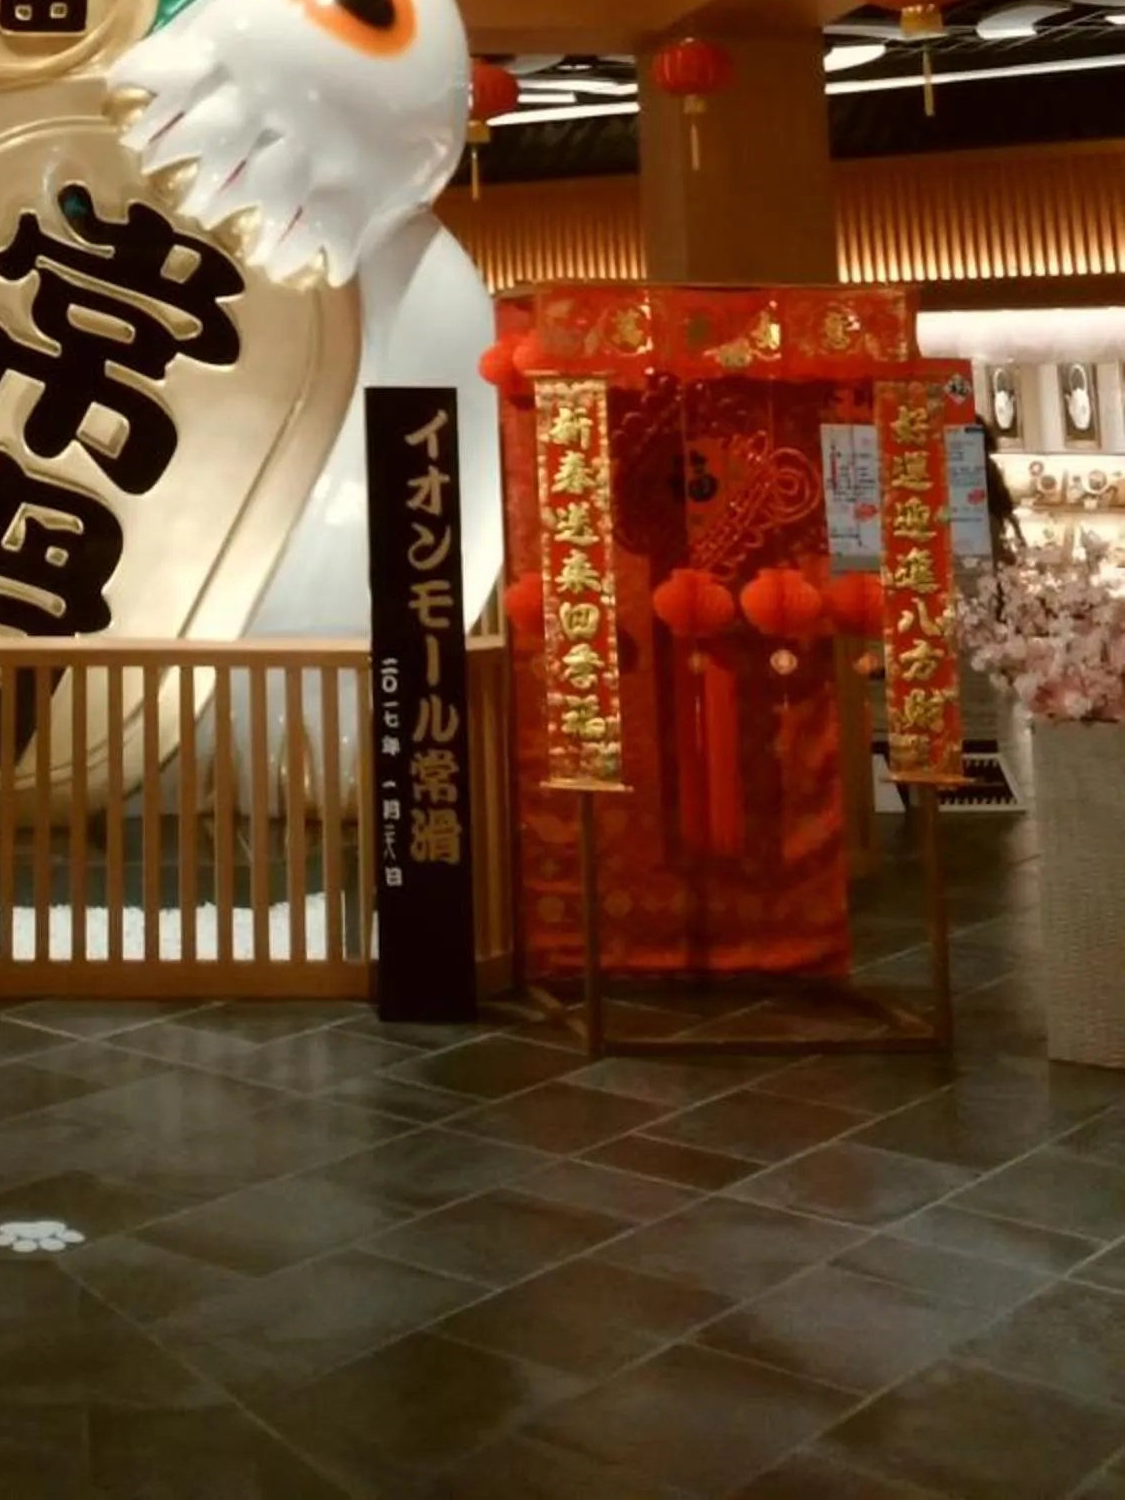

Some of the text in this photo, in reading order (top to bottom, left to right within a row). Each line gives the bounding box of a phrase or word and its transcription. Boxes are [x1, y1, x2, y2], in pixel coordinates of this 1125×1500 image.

[405, 409, 461, 865] イオンモール常滑
